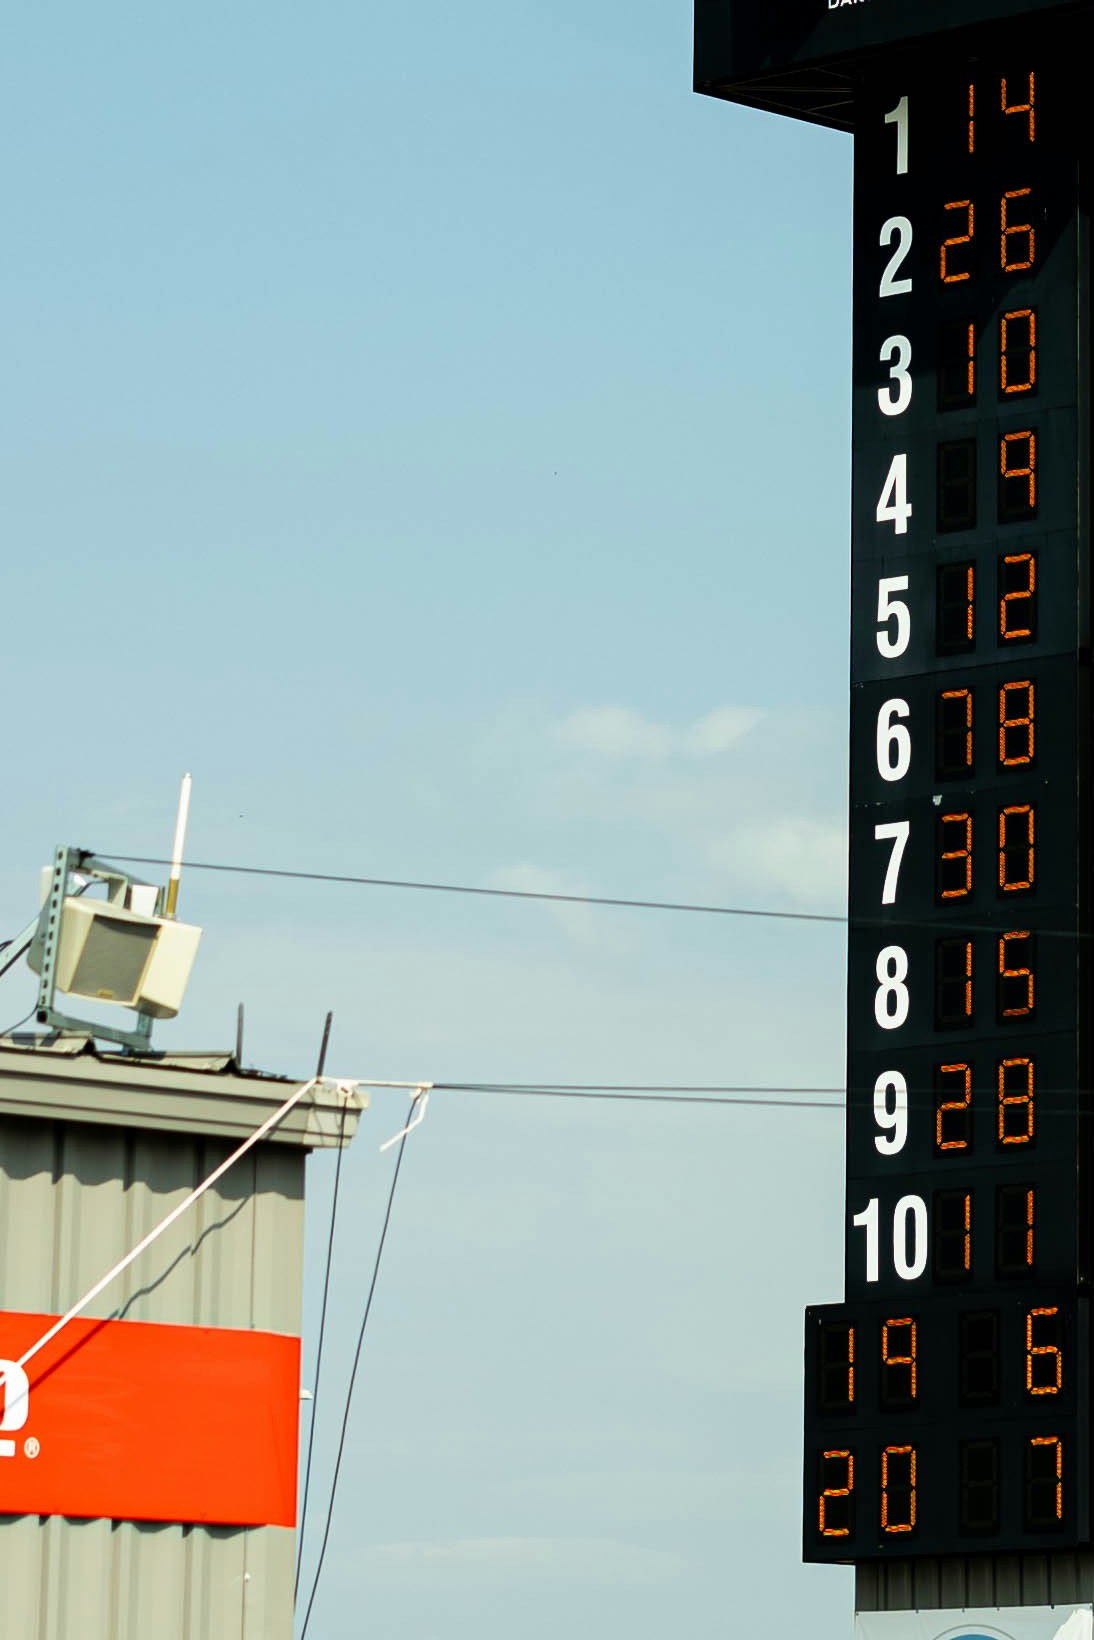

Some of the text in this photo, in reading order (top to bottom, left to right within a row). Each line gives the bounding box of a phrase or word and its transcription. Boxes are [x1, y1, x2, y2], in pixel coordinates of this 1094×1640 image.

[884, 71, 1036, 175] 1 14
[878, 187, 1036, 298] 2 26
[877, 308, 1037, 416] 3 10
[875, 430, 1036, 535] 4 9
[876, 553, 1036, 659] 5 12
[876, 679, 1035, 782] 6 78
[874, 804, 1035, 905] 7 30
[874, 930, 1034, 1030] 8 15
[873, 1057, 1034, 1156] 9 28
[853, 1189, 1034, 1283] 10 11
[847, 1306, 1063, 1403] 19 6
[818, 1435, 1063, 1537] 20 7
